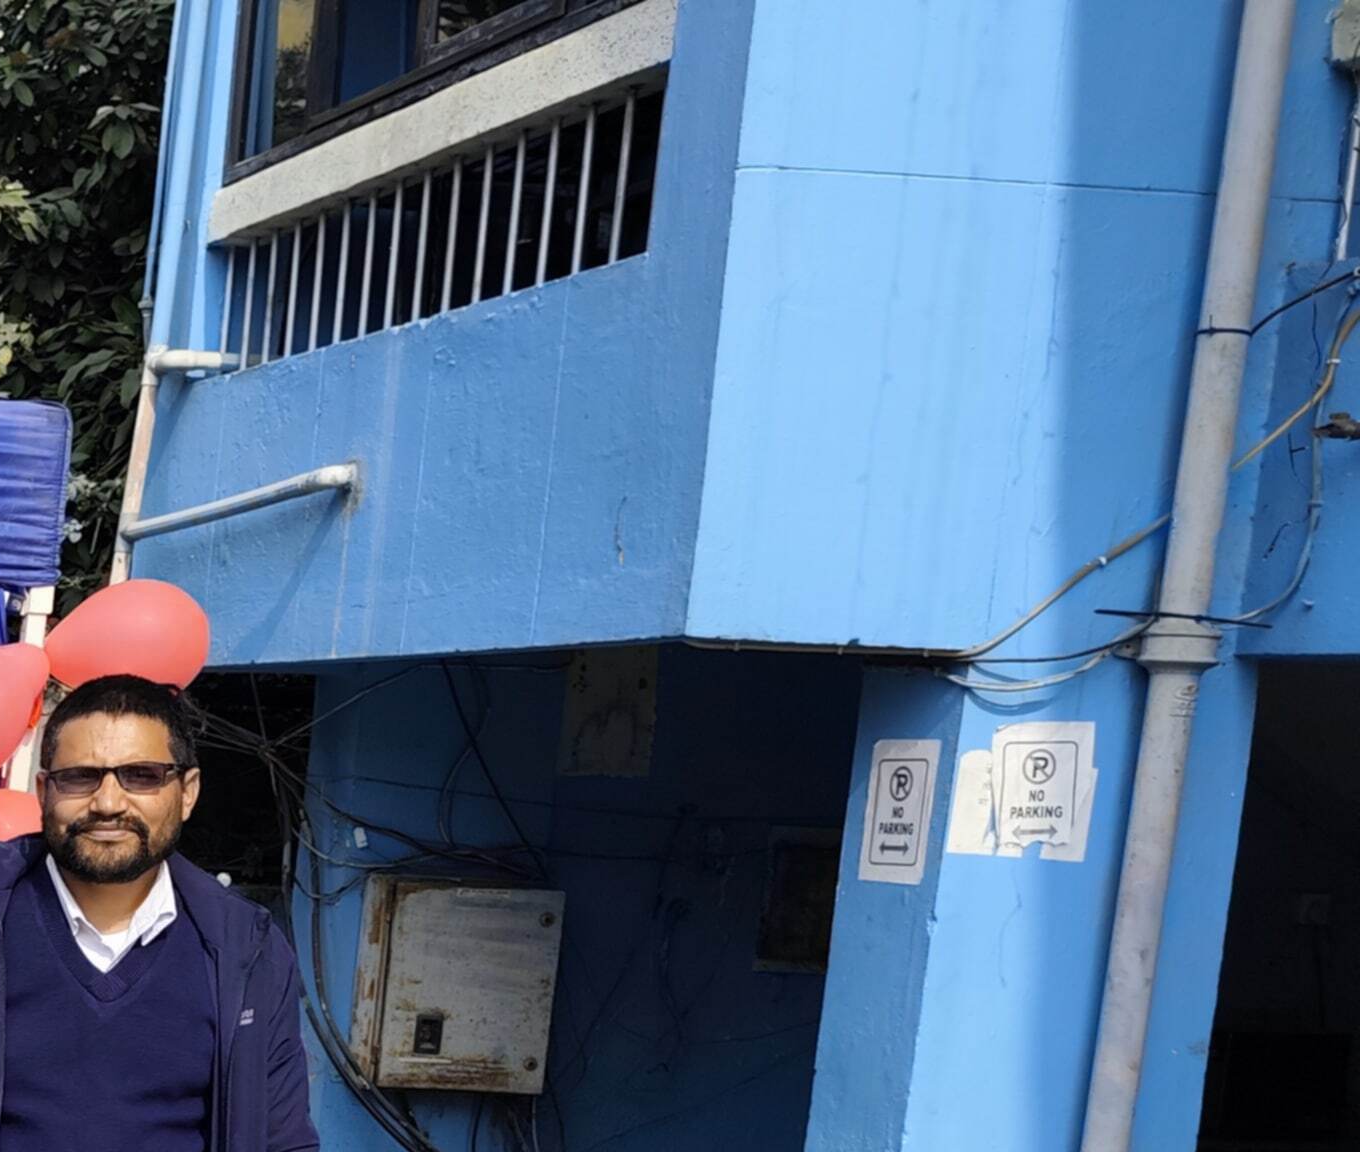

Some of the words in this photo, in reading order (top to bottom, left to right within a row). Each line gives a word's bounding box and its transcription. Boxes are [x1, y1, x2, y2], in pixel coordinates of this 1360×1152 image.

[1029, 790, 1045, 802] NO
[892, 807, 904, 818] NO
[1010, 806, 1063, 818] PARKING
[879, 823, 914, 835] PARKING
